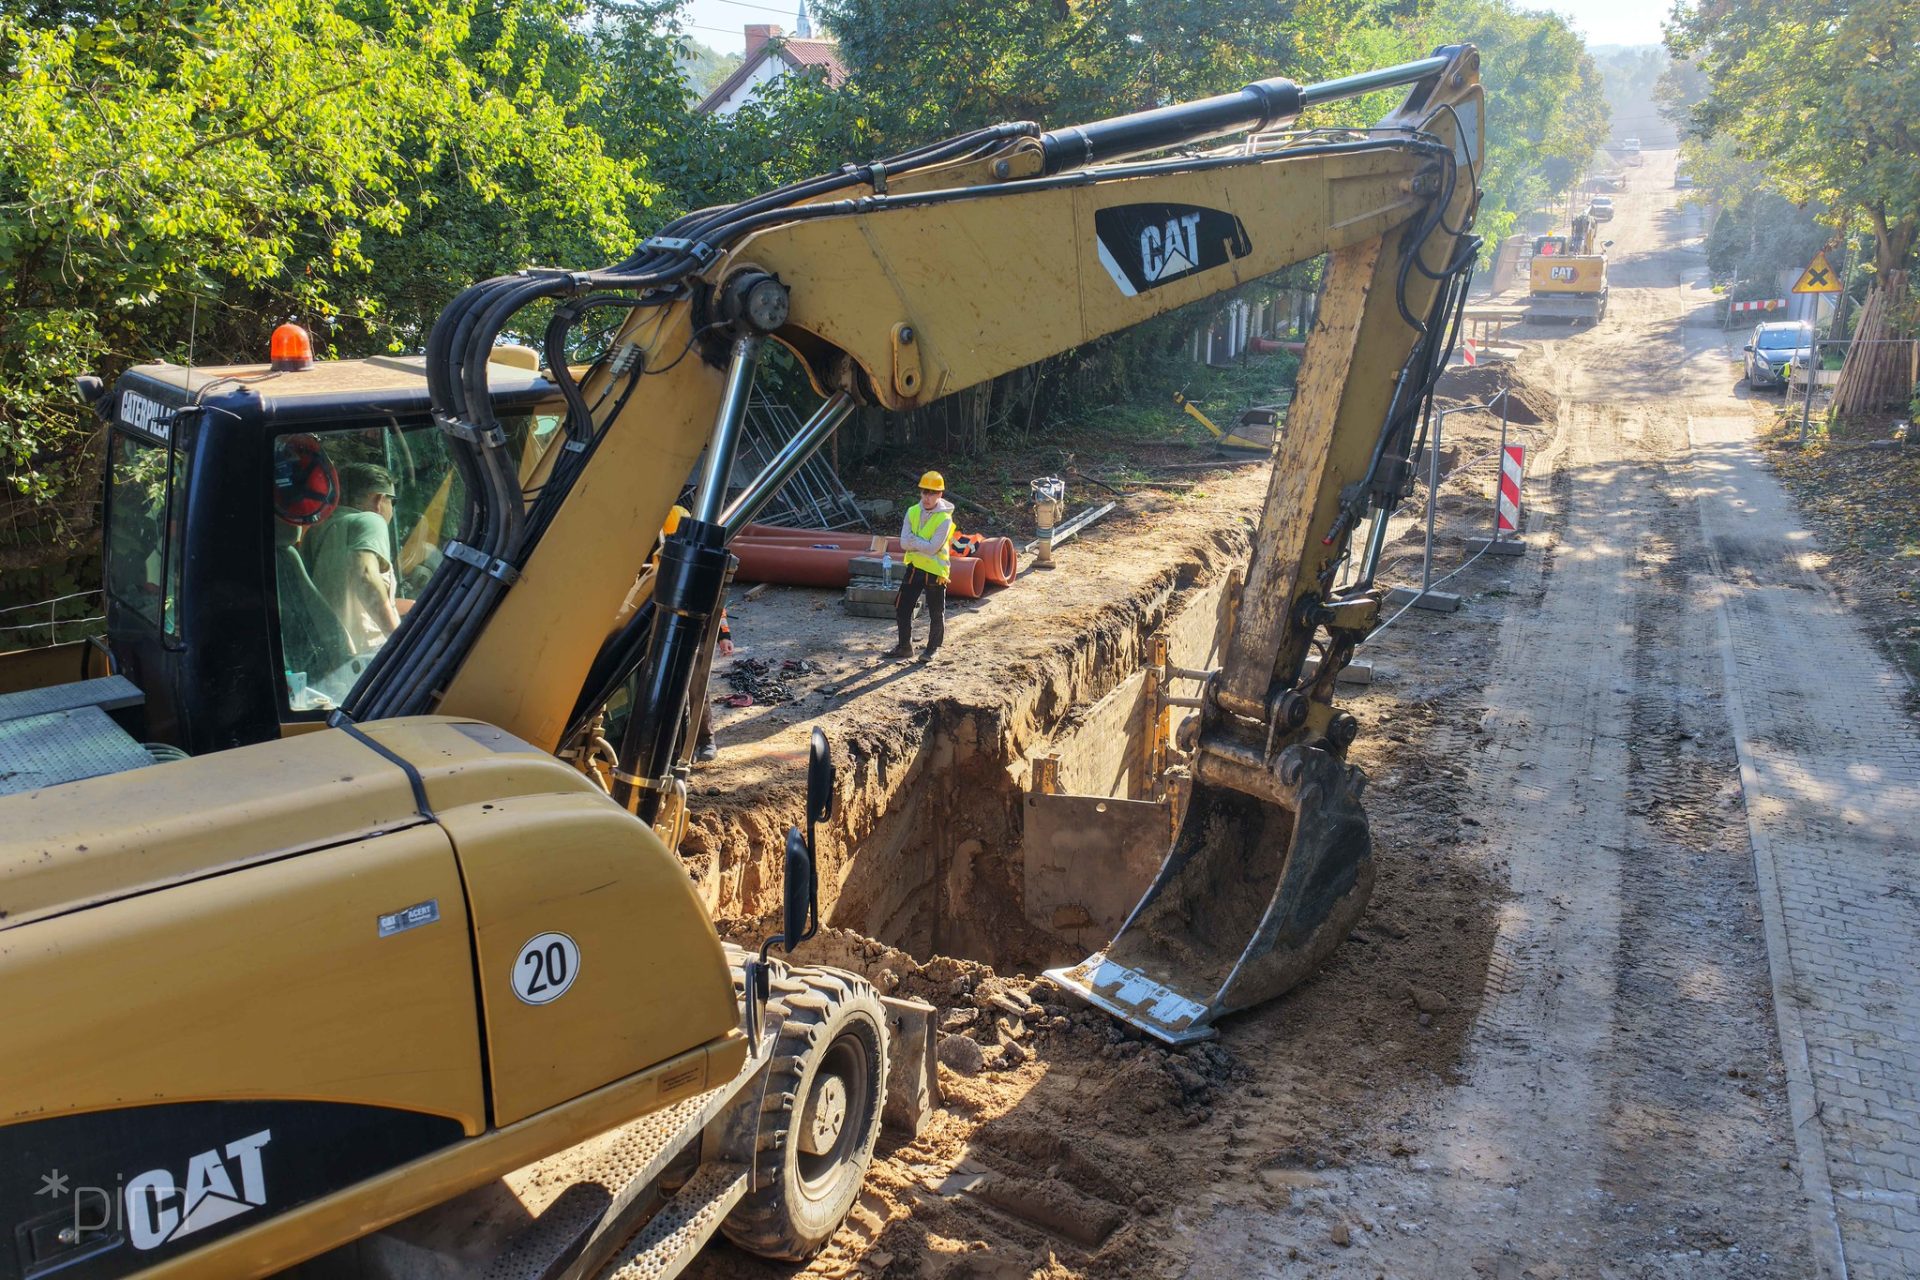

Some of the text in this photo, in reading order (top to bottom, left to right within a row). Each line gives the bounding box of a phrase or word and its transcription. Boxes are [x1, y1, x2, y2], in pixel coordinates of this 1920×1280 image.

[1141, 212, 1200, 282] CAT
[1551, 266, 1573, 280] CAT
[121, 390, 176, 440] CATERPILLA
[524, 941, 567, 996] 20
[124, 1128, 272, 1250] CAT
